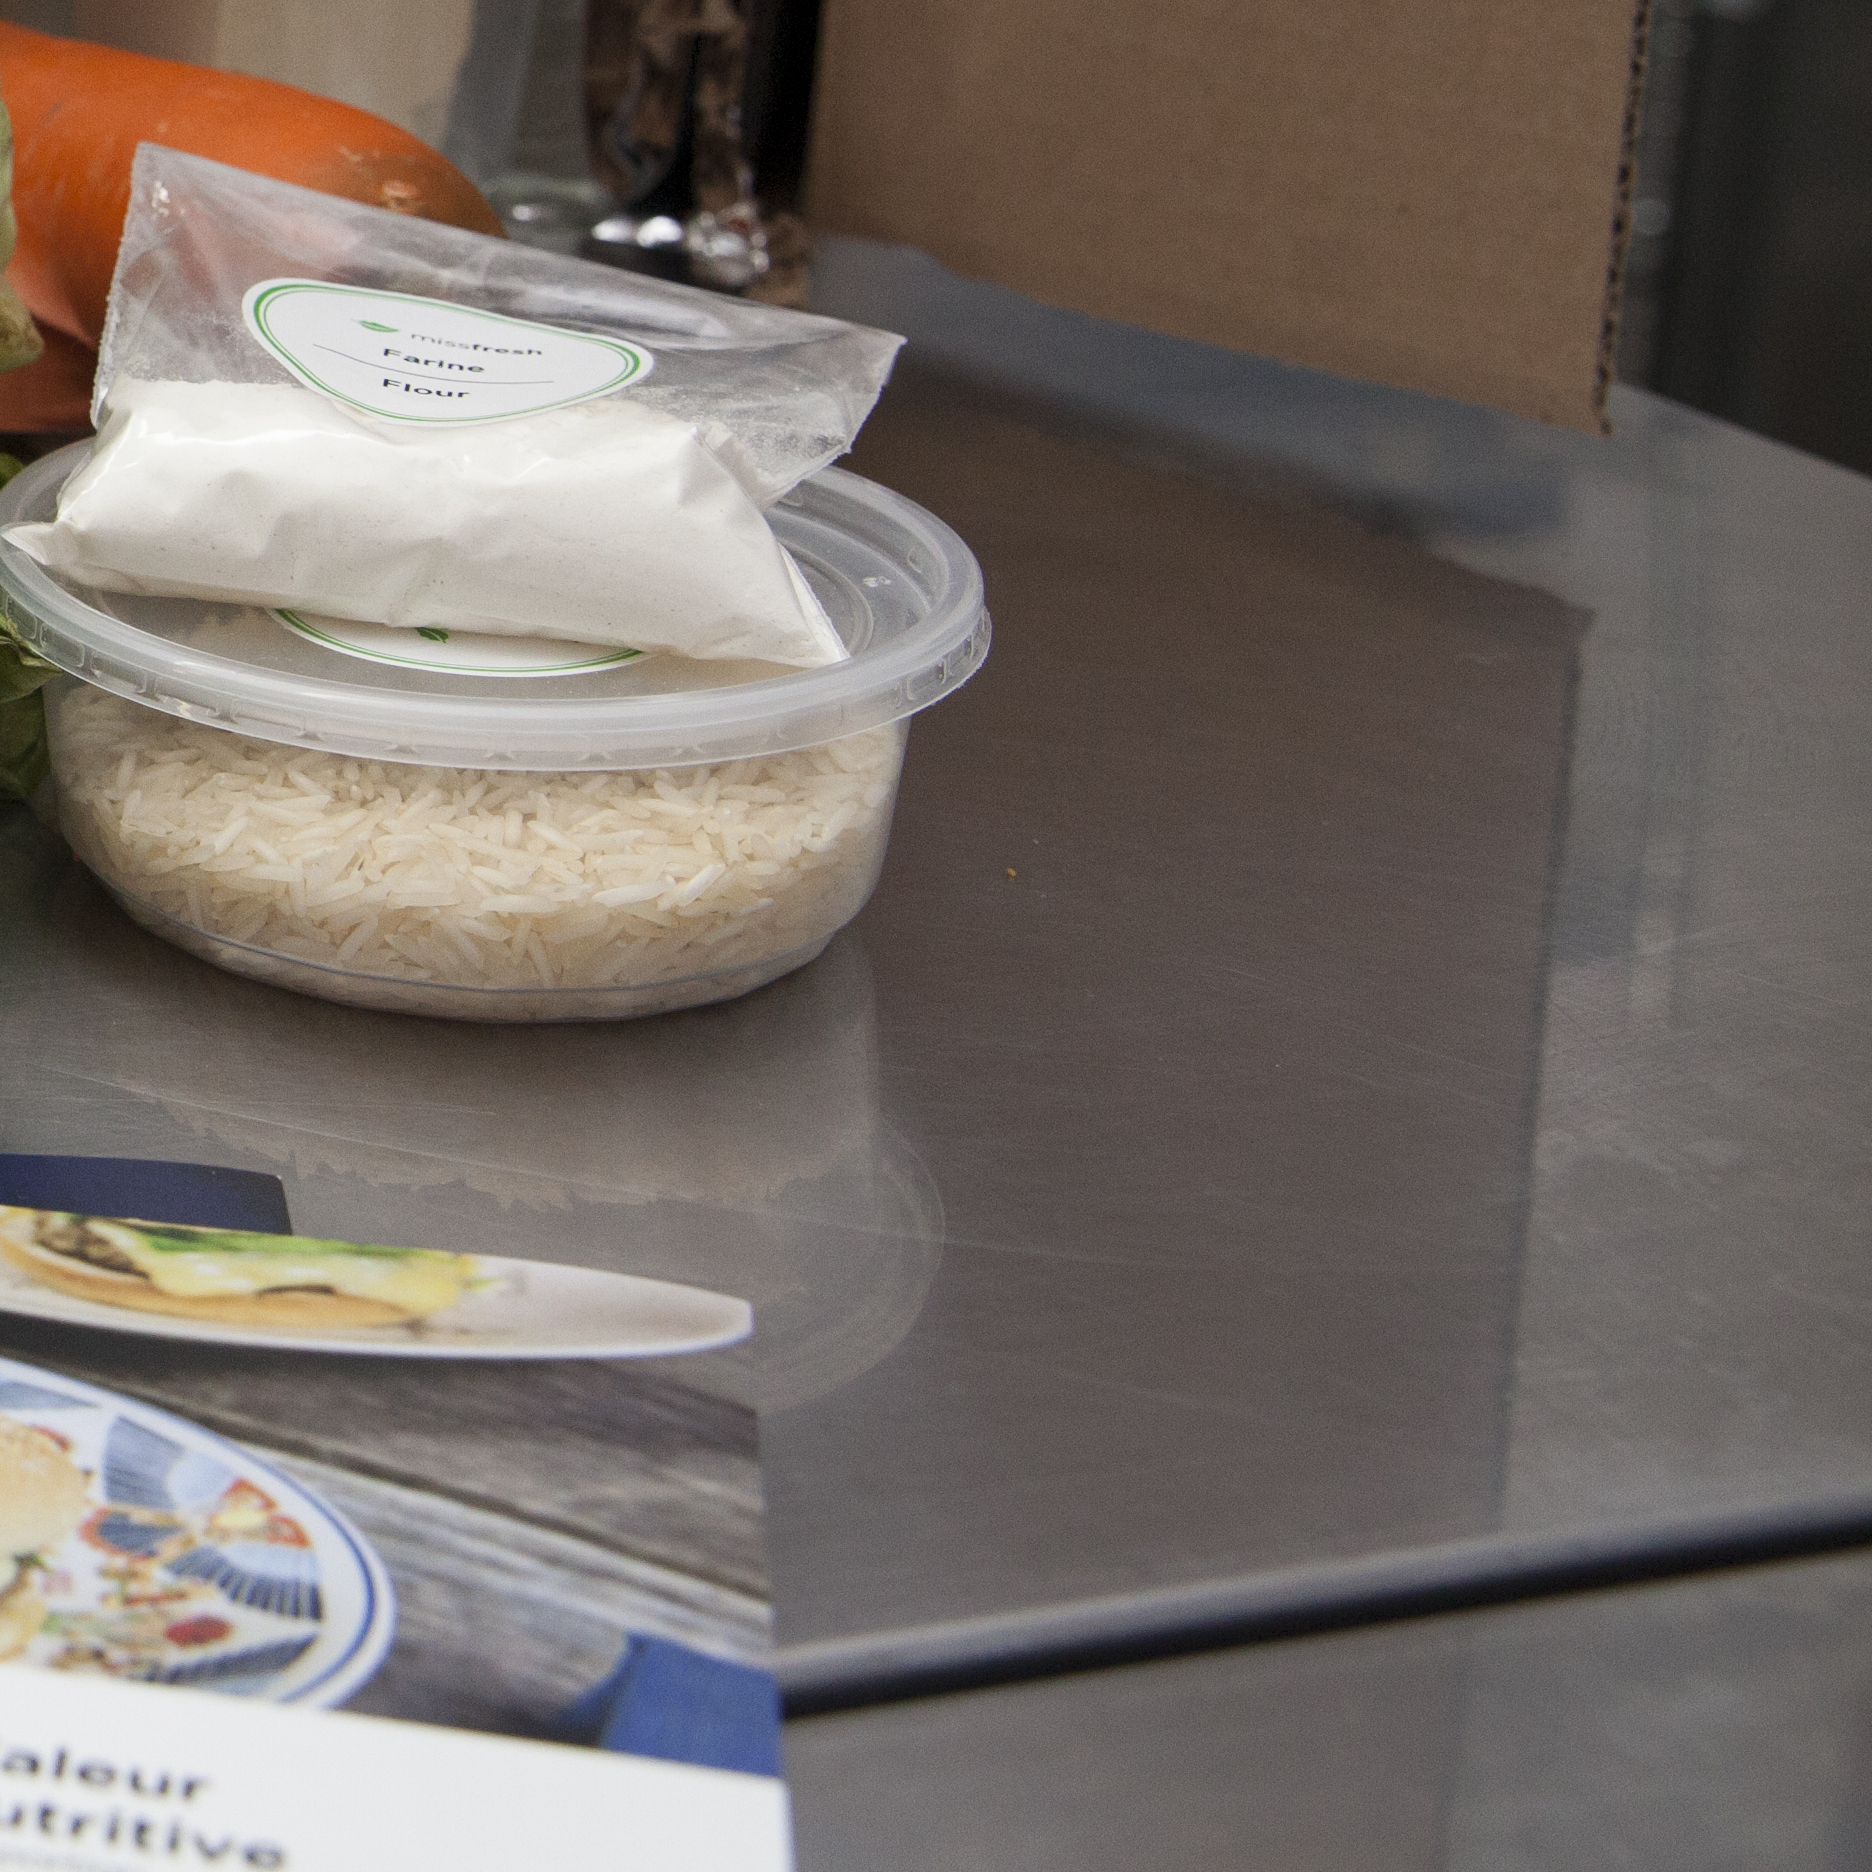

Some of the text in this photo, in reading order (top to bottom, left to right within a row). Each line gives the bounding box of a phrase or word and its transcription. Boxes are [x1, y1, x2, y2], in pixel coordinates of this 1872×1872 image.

[410, 333, 543, 356] missfresh
[382, 348, 485, 373] Farine
[382, 377, 471, 399] Flour
